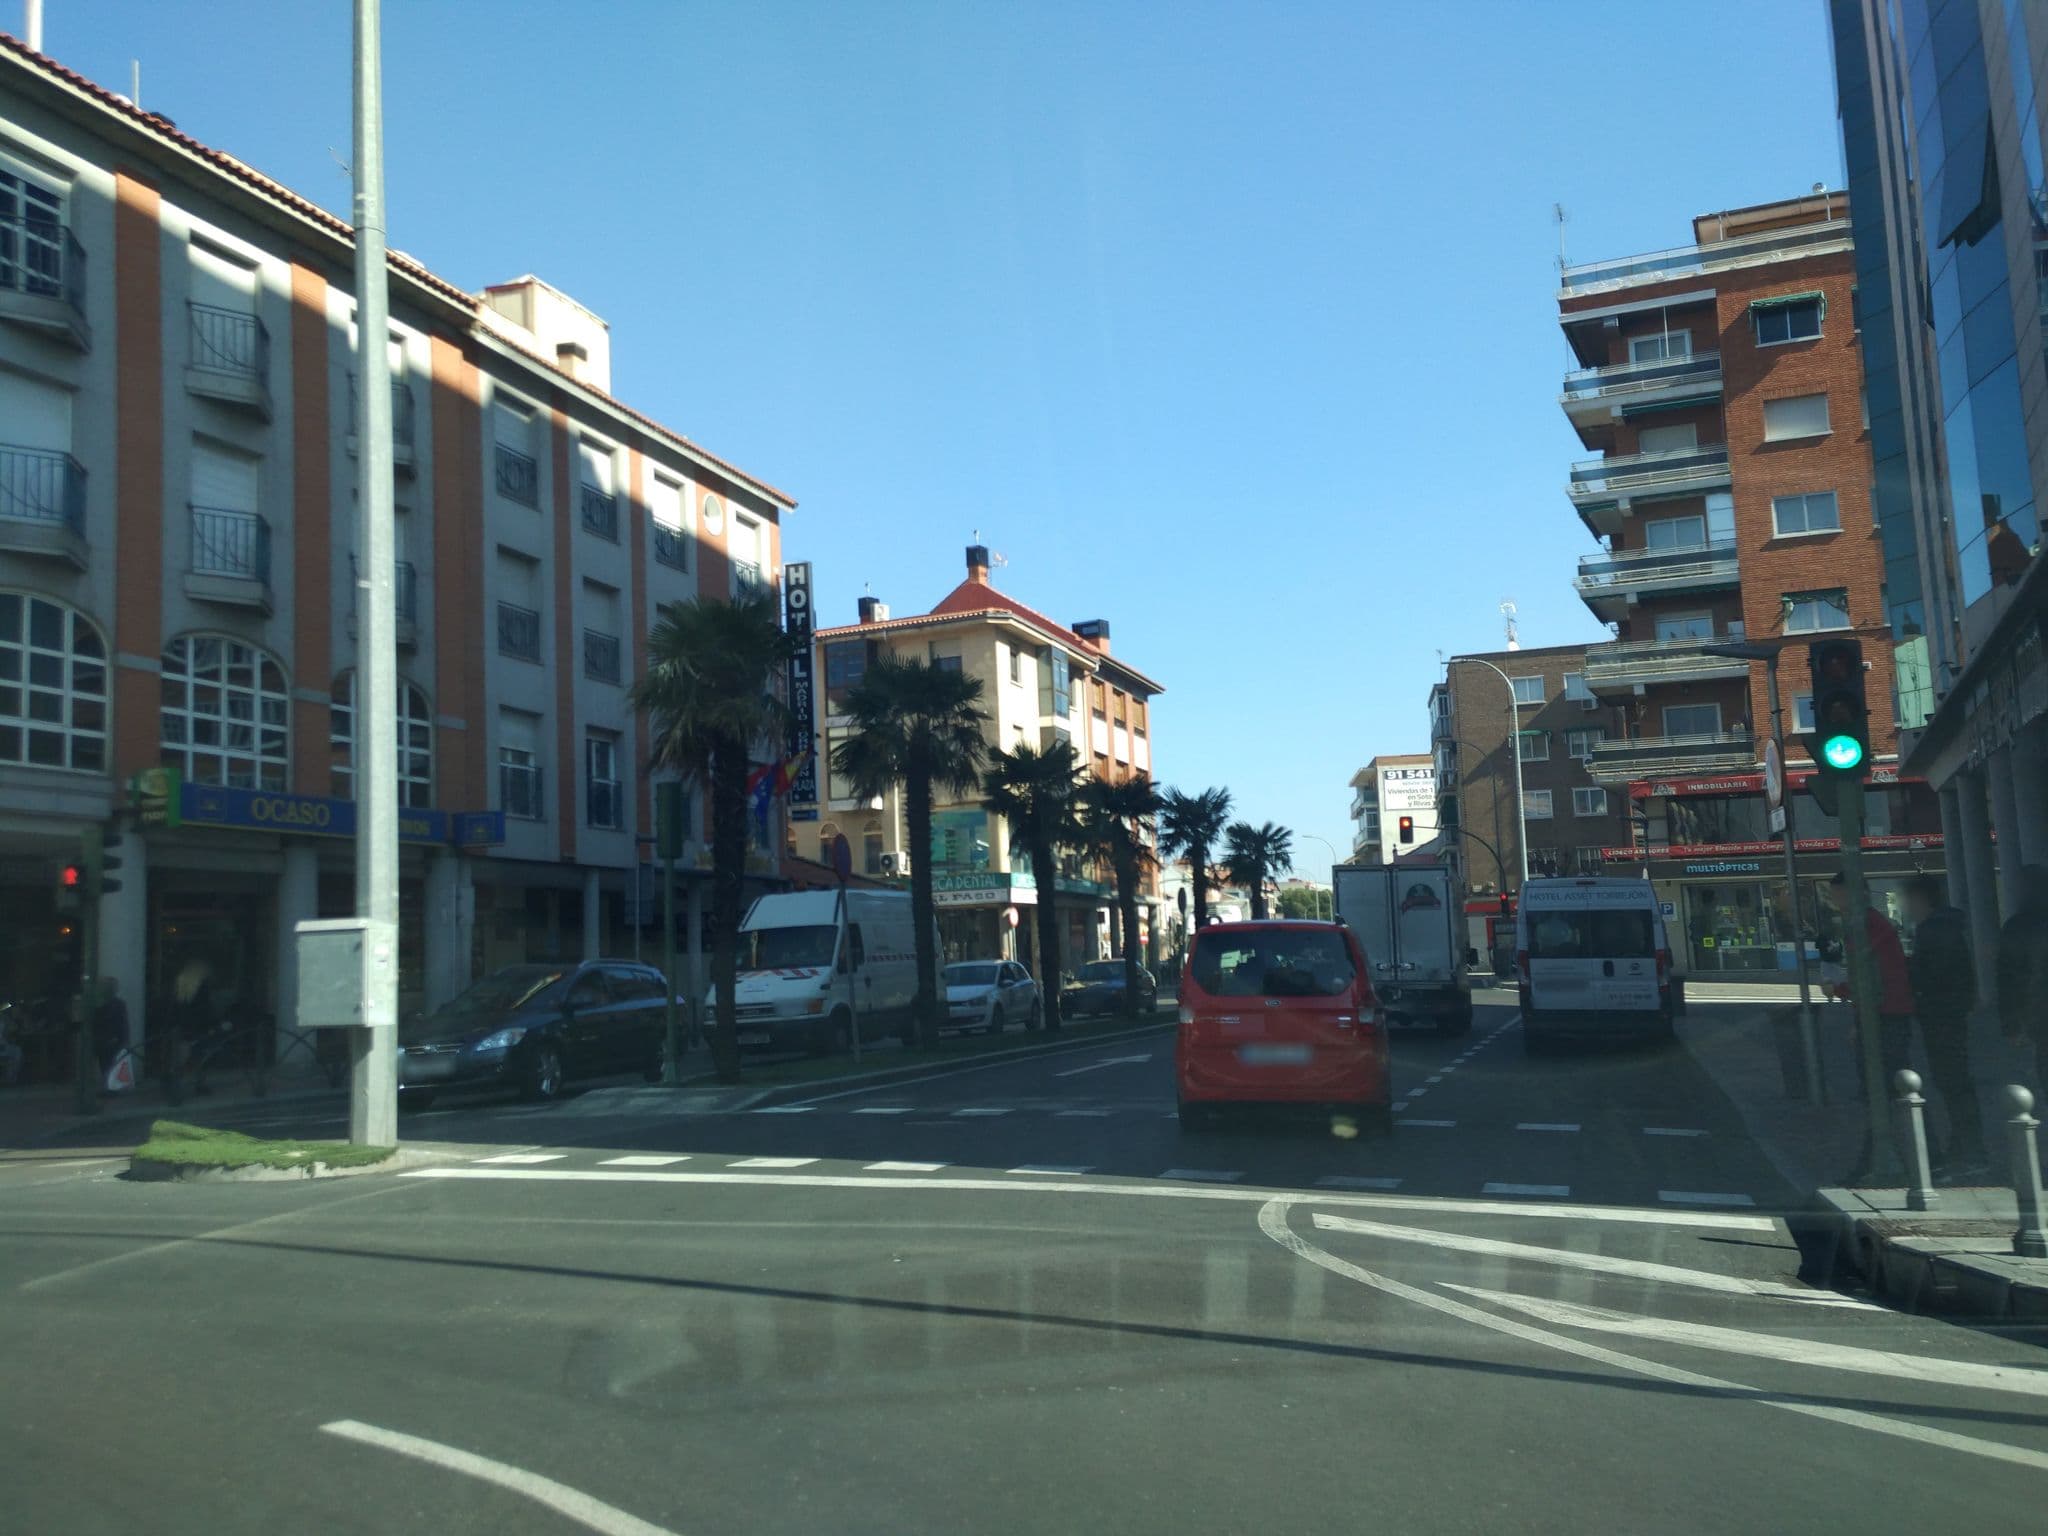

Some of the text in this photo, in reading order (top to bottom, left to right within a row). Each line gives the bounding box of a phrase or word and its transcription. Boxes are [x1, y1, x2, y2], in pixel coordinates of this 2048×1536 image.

[1387, 769, 1432, 780] 91 541
[1687, 780, 1748, 791] INMOBILIARIA
[252, 797, 330, 827] OCASO
[956, 874, 998, 889] DENTAL
